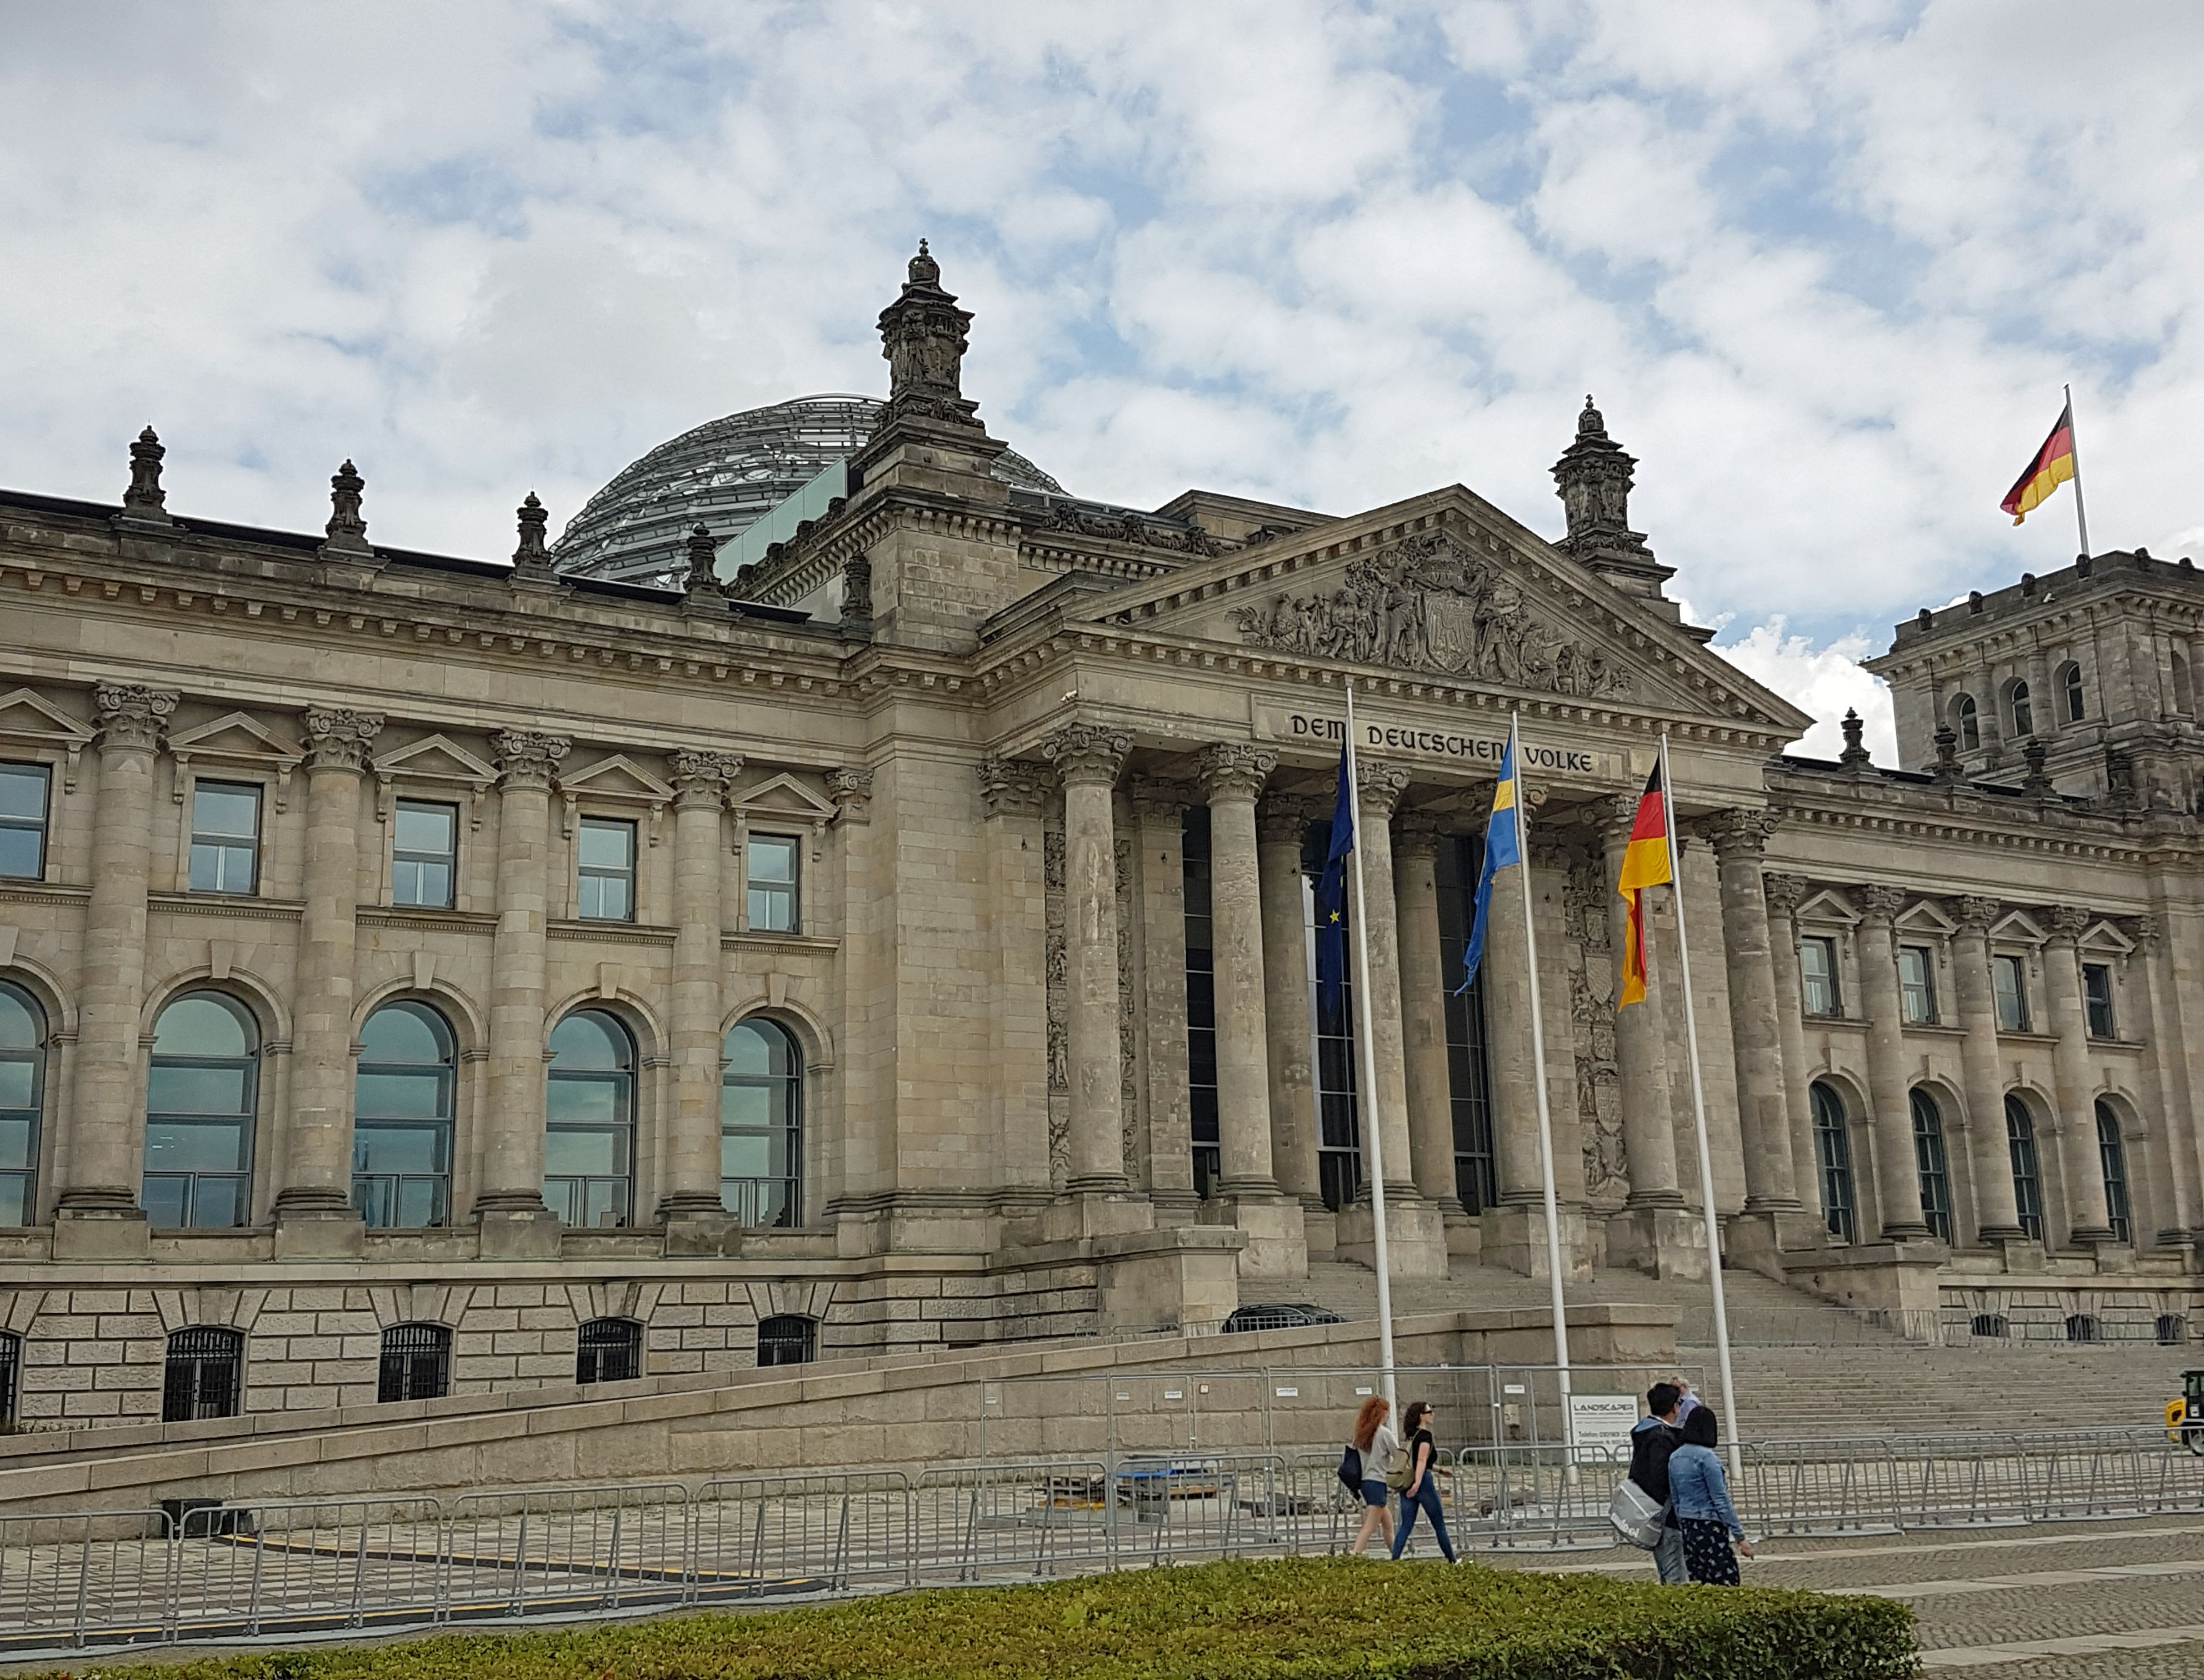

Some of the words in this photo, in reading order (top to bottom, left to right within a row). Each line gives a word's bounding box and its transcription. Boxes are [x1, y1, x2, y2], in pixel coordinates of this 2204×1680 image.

[1291, 715, 1346, 739] DEM
[1367, 726, 1503, 761] DEUTSCHEN
[1524, 747, 1592, 772] VOLKE
